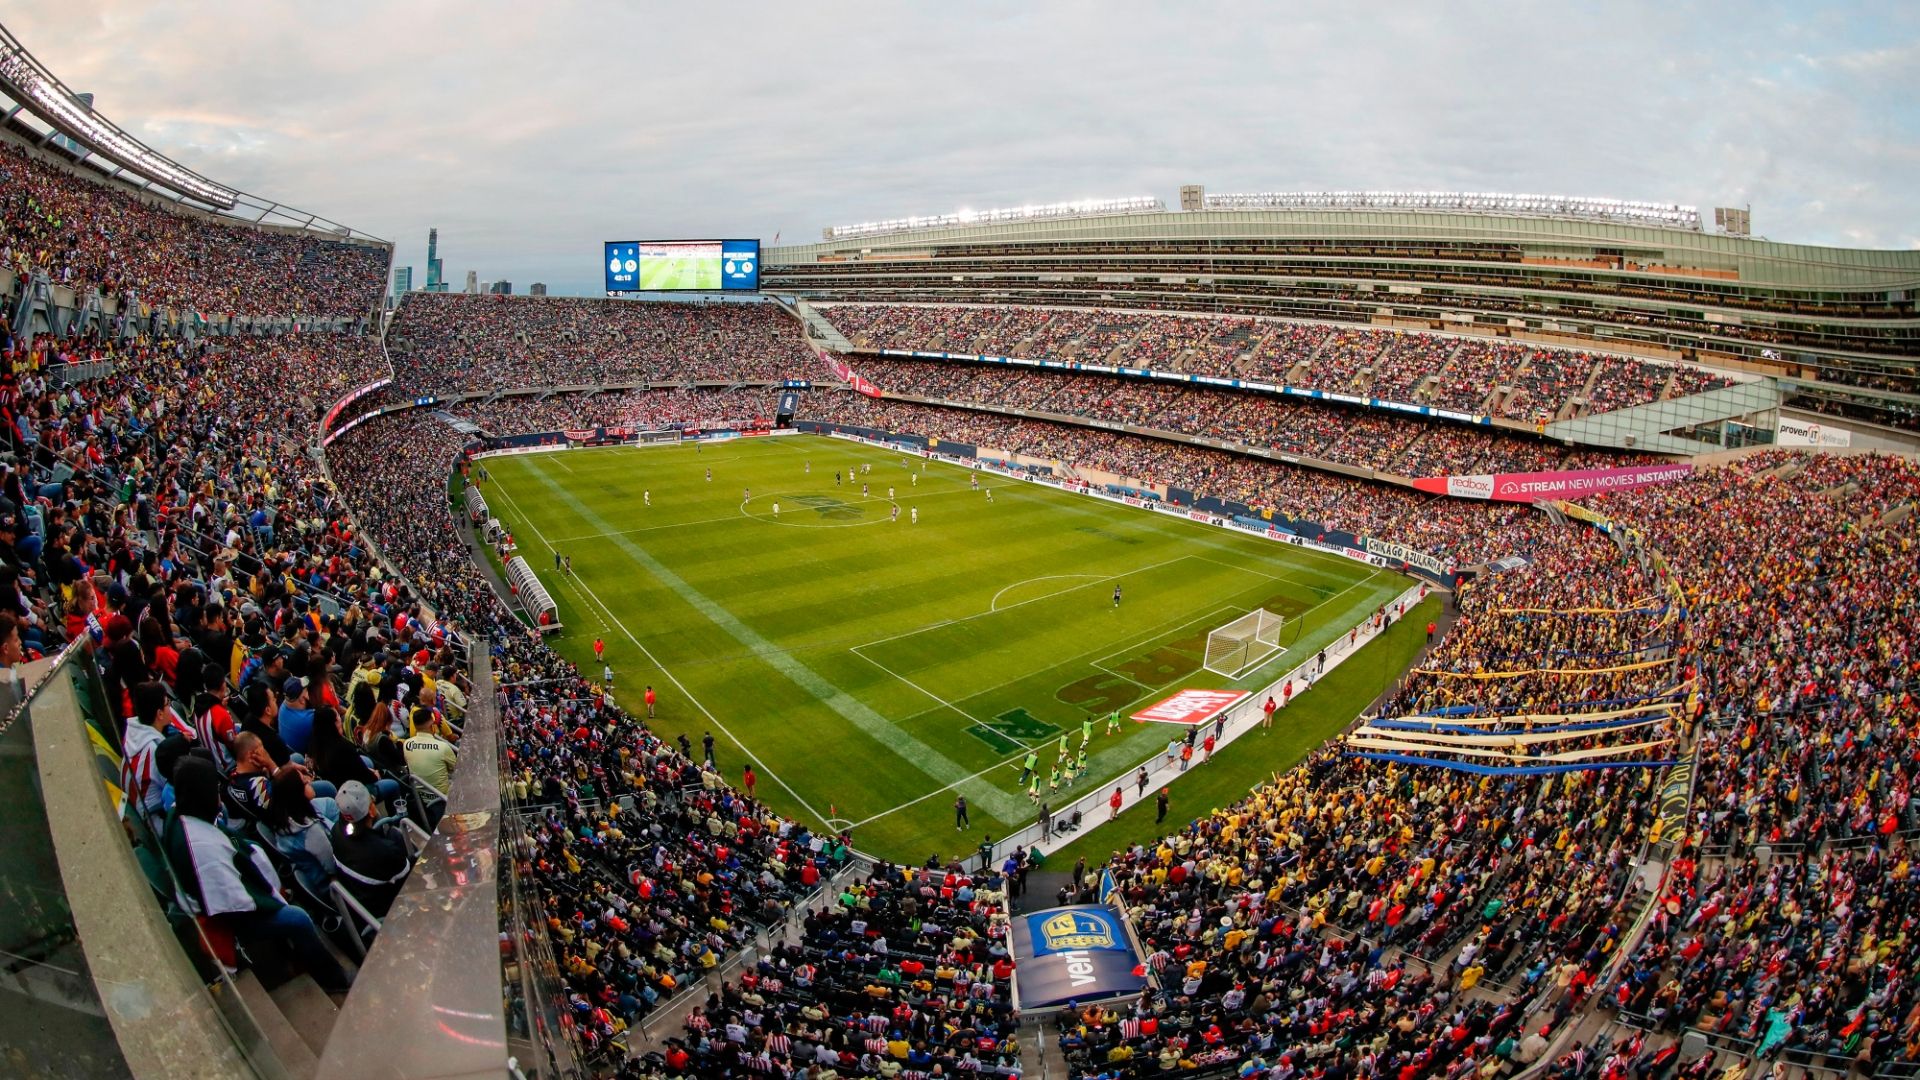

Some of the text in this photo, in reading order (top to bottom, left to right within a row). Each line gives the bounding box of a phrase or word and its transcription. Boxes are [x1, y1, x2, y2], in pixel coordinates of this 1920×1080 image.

[1780, 425, 1818, 440] proven IT
[1521, 468, 1689, 493] STREAM NEW MOVIES INSTANTLY
[1190, 510, 1210, 522] TECATE
[1267, 530, 1289, 541] TECATE
[1346, 548, 1368, 561] TECATE
[1369, 540, 1403, 557] CHIKAGO
[405, 740, 440, 752] Corona
